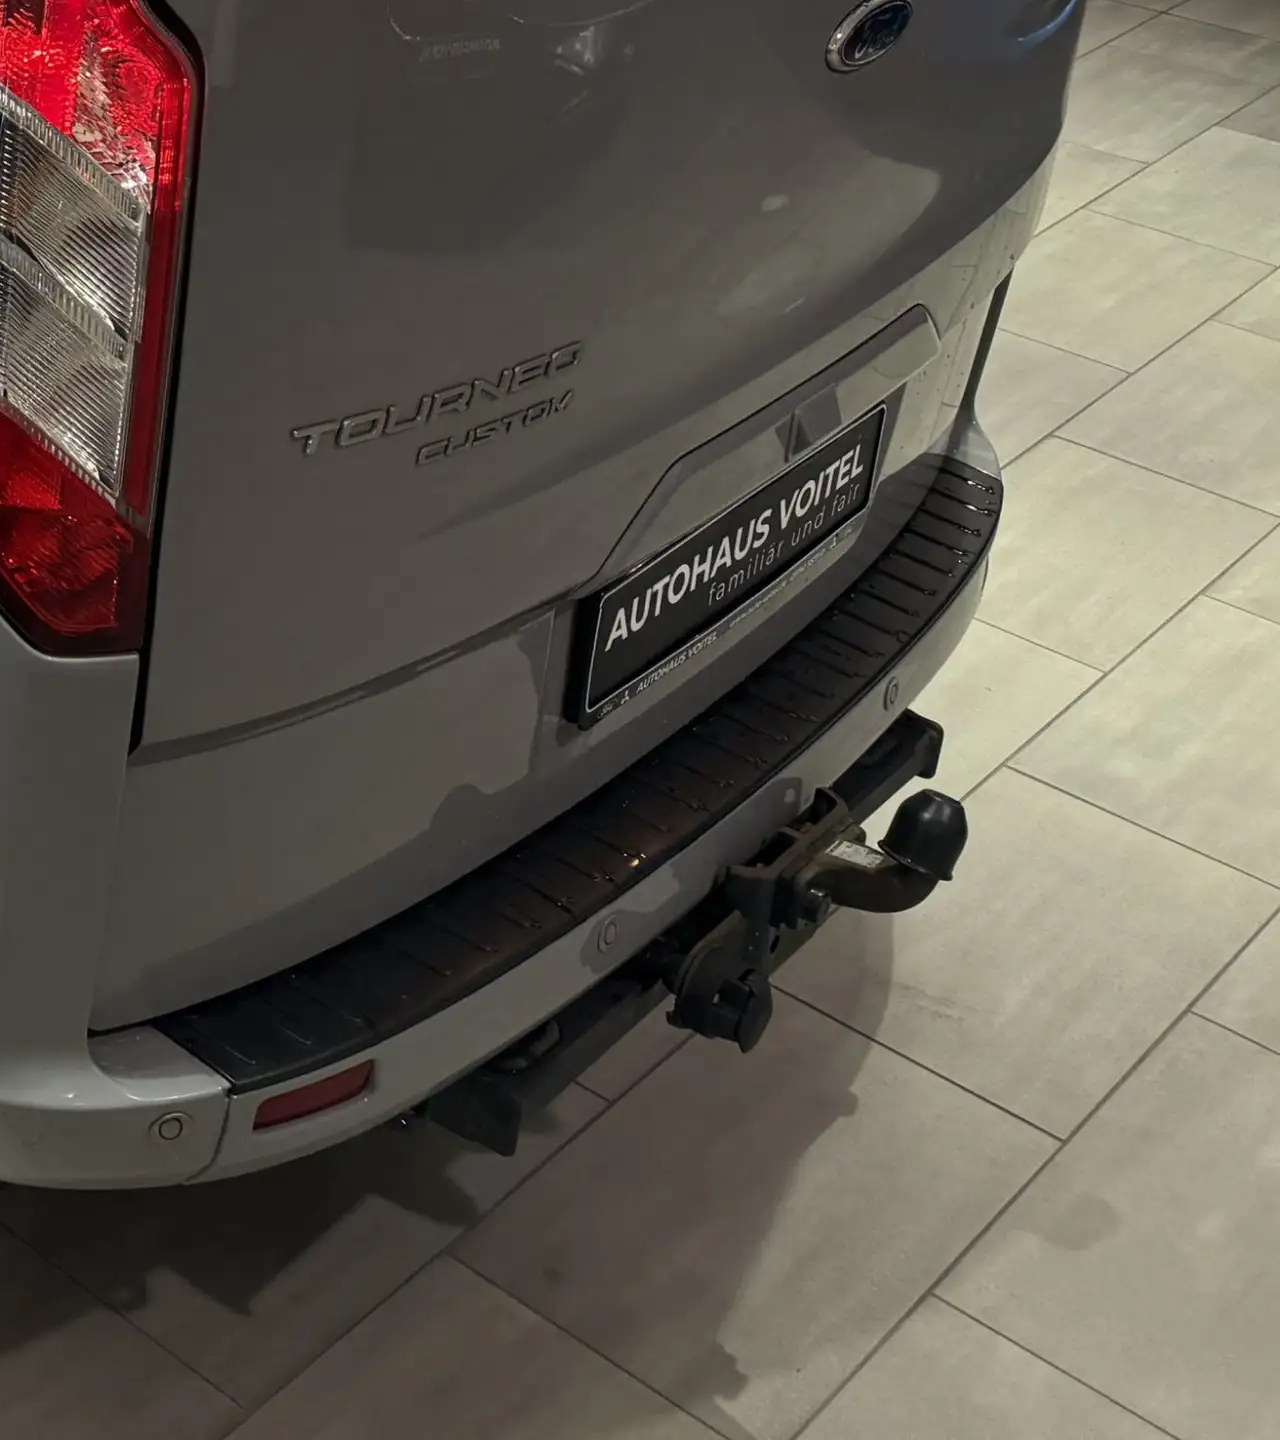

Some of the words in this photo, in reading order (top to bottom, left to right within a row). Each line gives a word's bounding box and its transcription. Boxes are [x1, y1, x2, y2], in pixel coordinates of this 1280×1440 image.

[291, 340, 583, 456] TOURNEO
[415, 388, 574, 466] CUSTOM
[604, 508, 772, 653] AUTOHAUS
[779, 443, 864, 530] VOITEL
[708, 538, 785, 606] familiär
[791, 509, 825, 548] und
[830, 481, 861, 517] fair
[636, 650, 687, 694] AUTOHAUS
[687, 632, 719, 659] VOITEL
